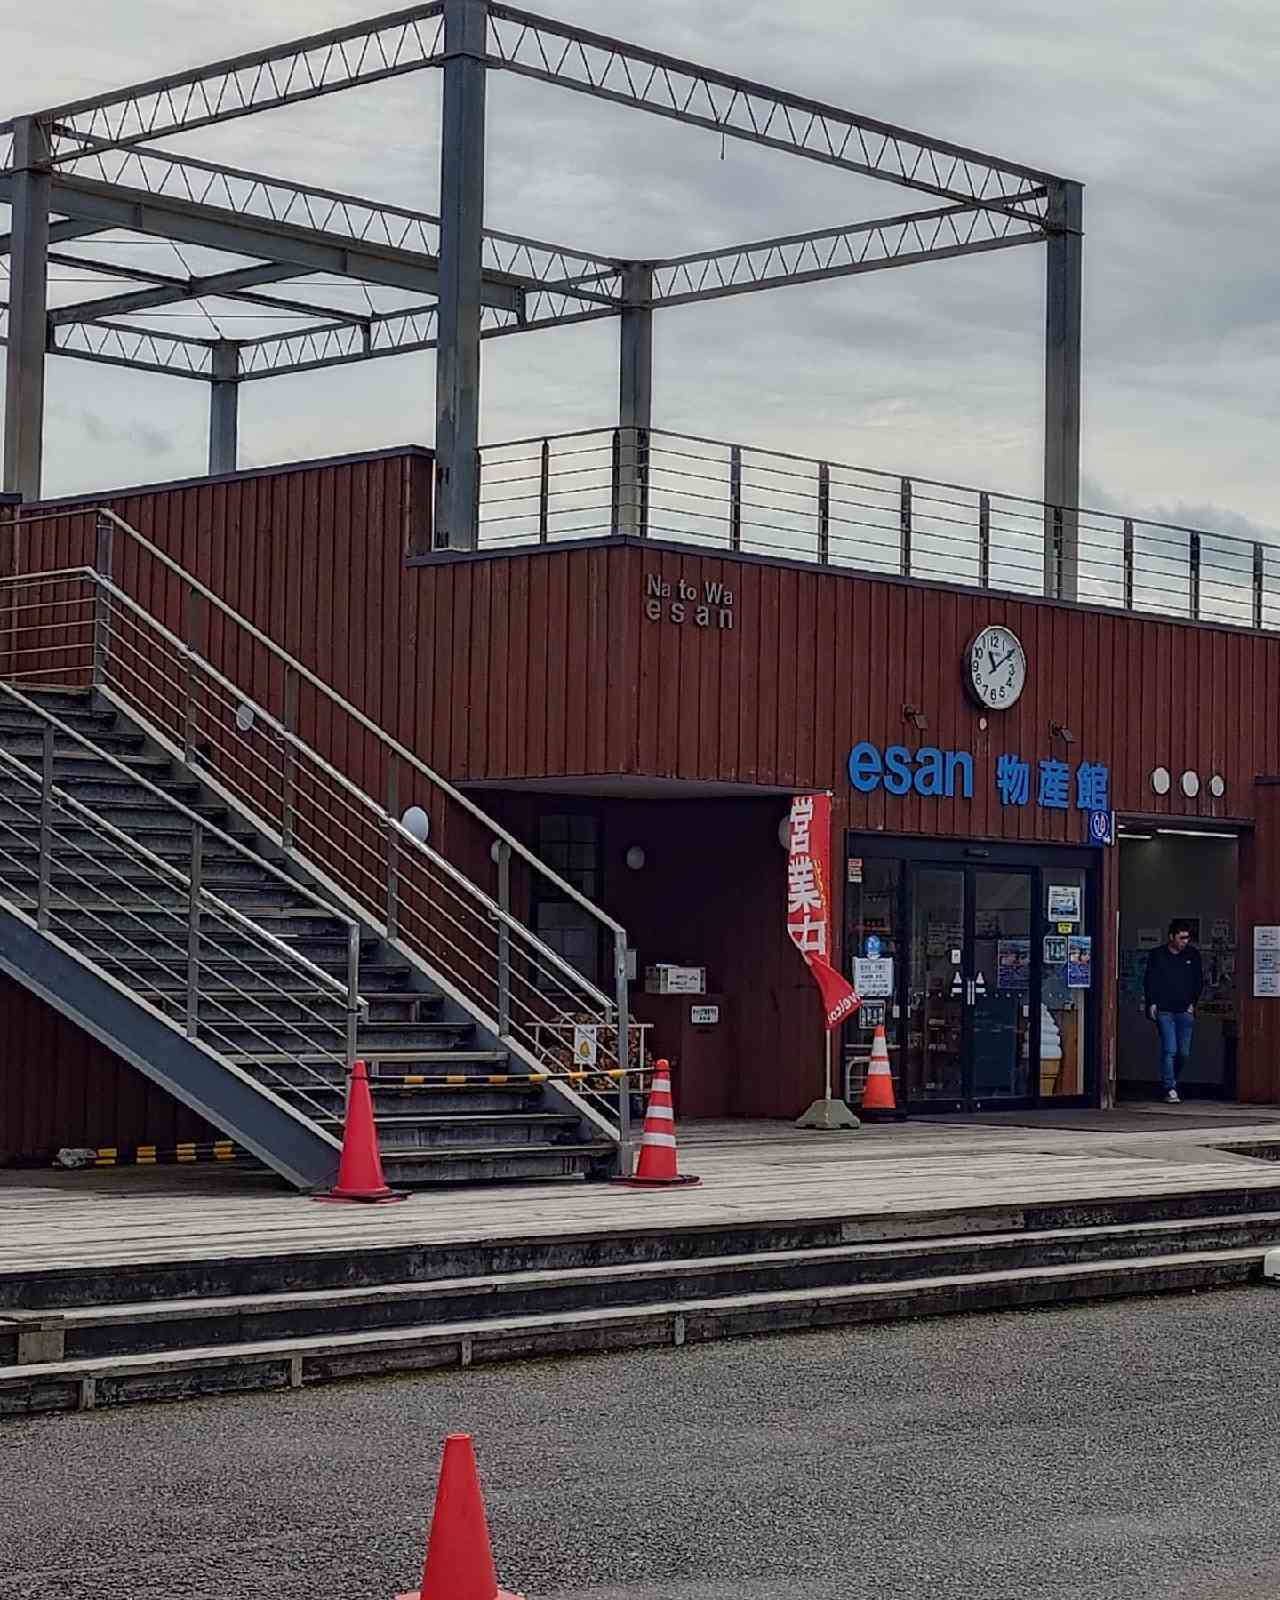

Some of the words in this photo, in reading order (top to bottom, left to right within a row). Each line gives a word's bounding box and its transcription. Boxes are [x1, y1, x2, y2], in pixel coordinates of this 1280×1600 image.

[646, 599, 733, 629] esan
[647, 574, 671, 597] Na
[679, 579, 697, 600] to
[705, 581, 733, 605] Wa
[848, 741, 973, 799] esan
[996, 753, 1109, 811] 物産館
[787, 796, 826, 956] 営業中
